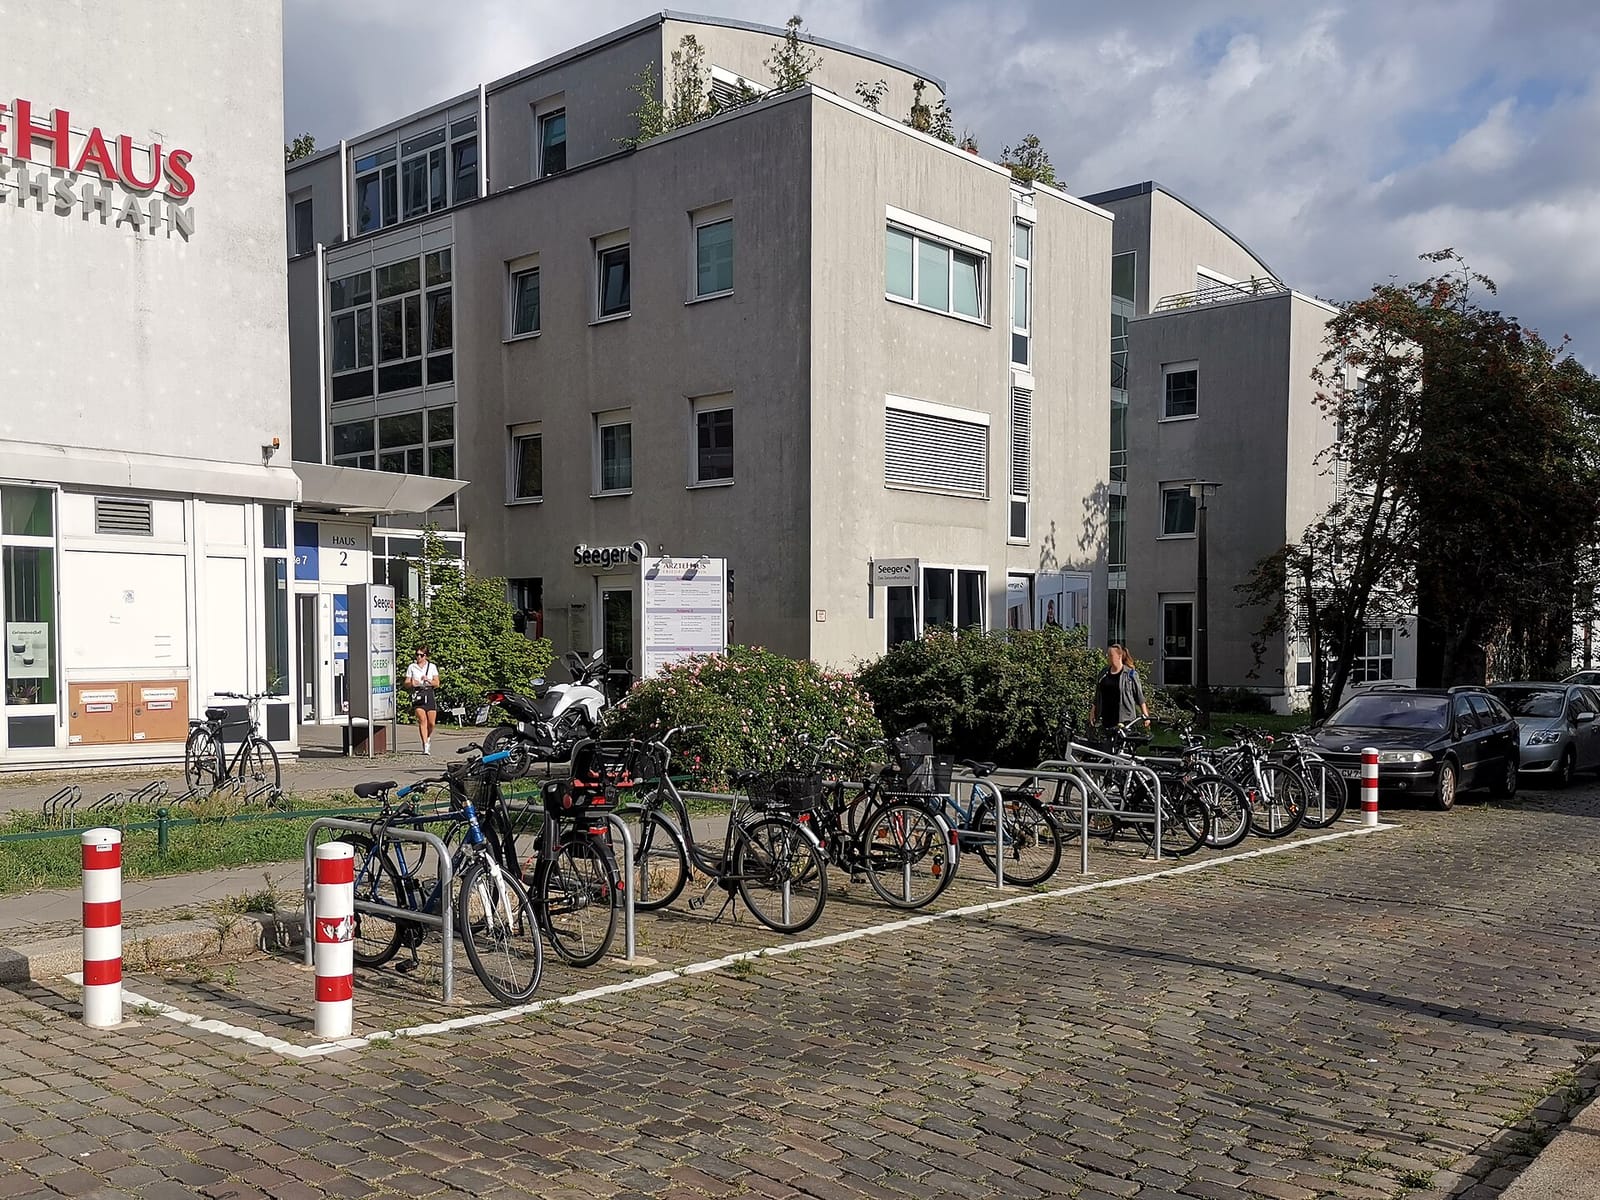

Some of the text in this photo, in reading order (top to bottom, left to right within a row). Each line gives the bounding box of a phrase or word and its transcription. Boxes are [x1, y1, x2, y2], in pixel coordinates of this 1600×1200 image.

[332, 535, 356, 546] HAUS
[302, 555, 308, 565] 7
[339, 551, 348, 567] 2
[574, 545, 627, 568] Seeger
[878, 564, 904, 575] Seeger
[372, 659, 388, 669] GEERS
